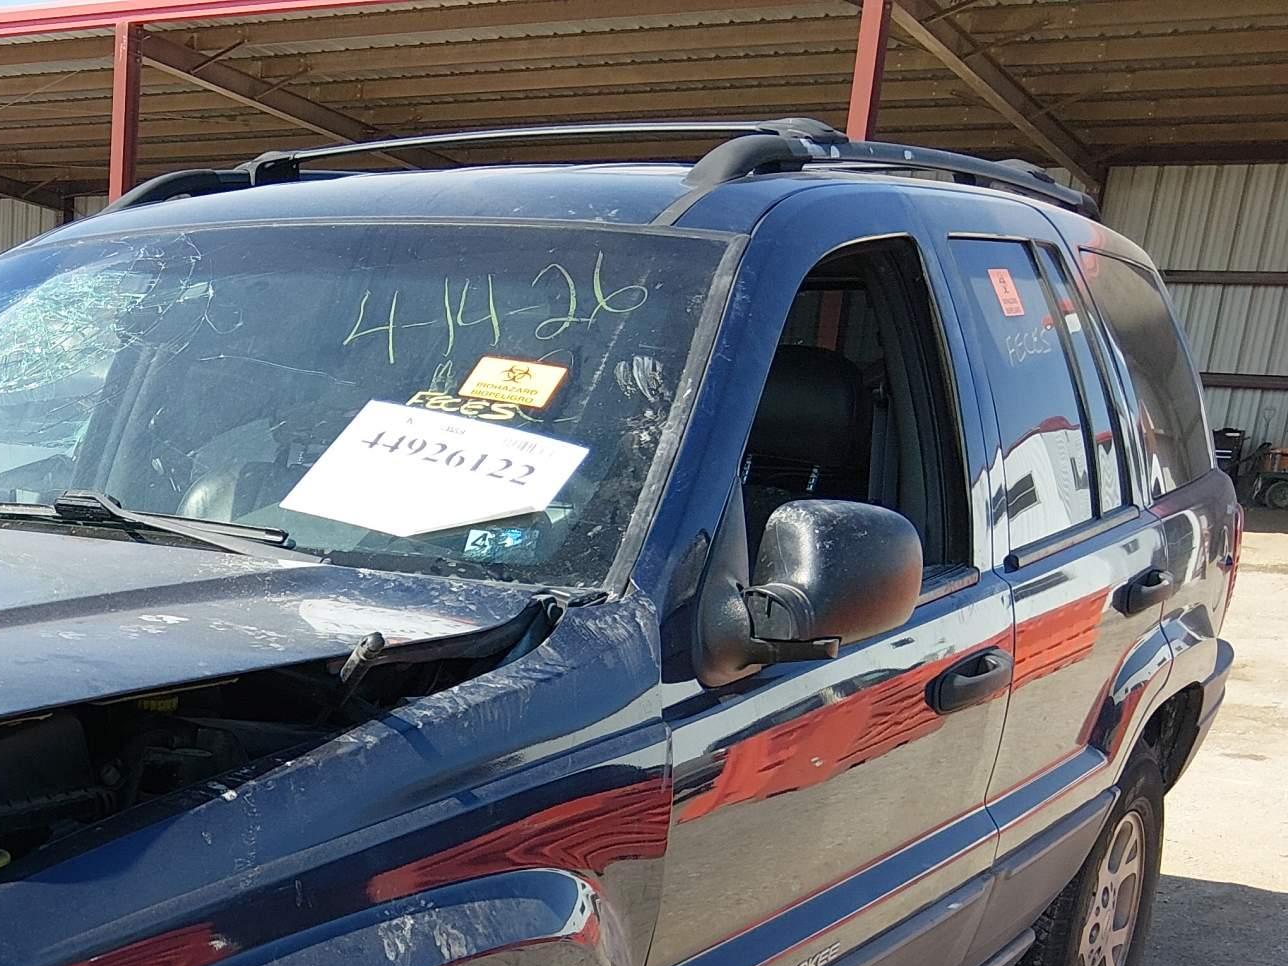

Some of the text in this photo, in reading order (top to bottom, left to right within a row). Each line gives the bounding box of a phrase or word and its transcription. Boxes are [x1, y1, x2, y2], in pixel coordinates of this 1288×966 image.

[343, 250, 648, 365] 4-14-26
[470, 389, 535, 404] BIOPELIGRO
[476, 381, 539, 396] BIOHAZARD
[406, 391, 517, 420] FECES
[361, 431, 537, 486] 44926122
